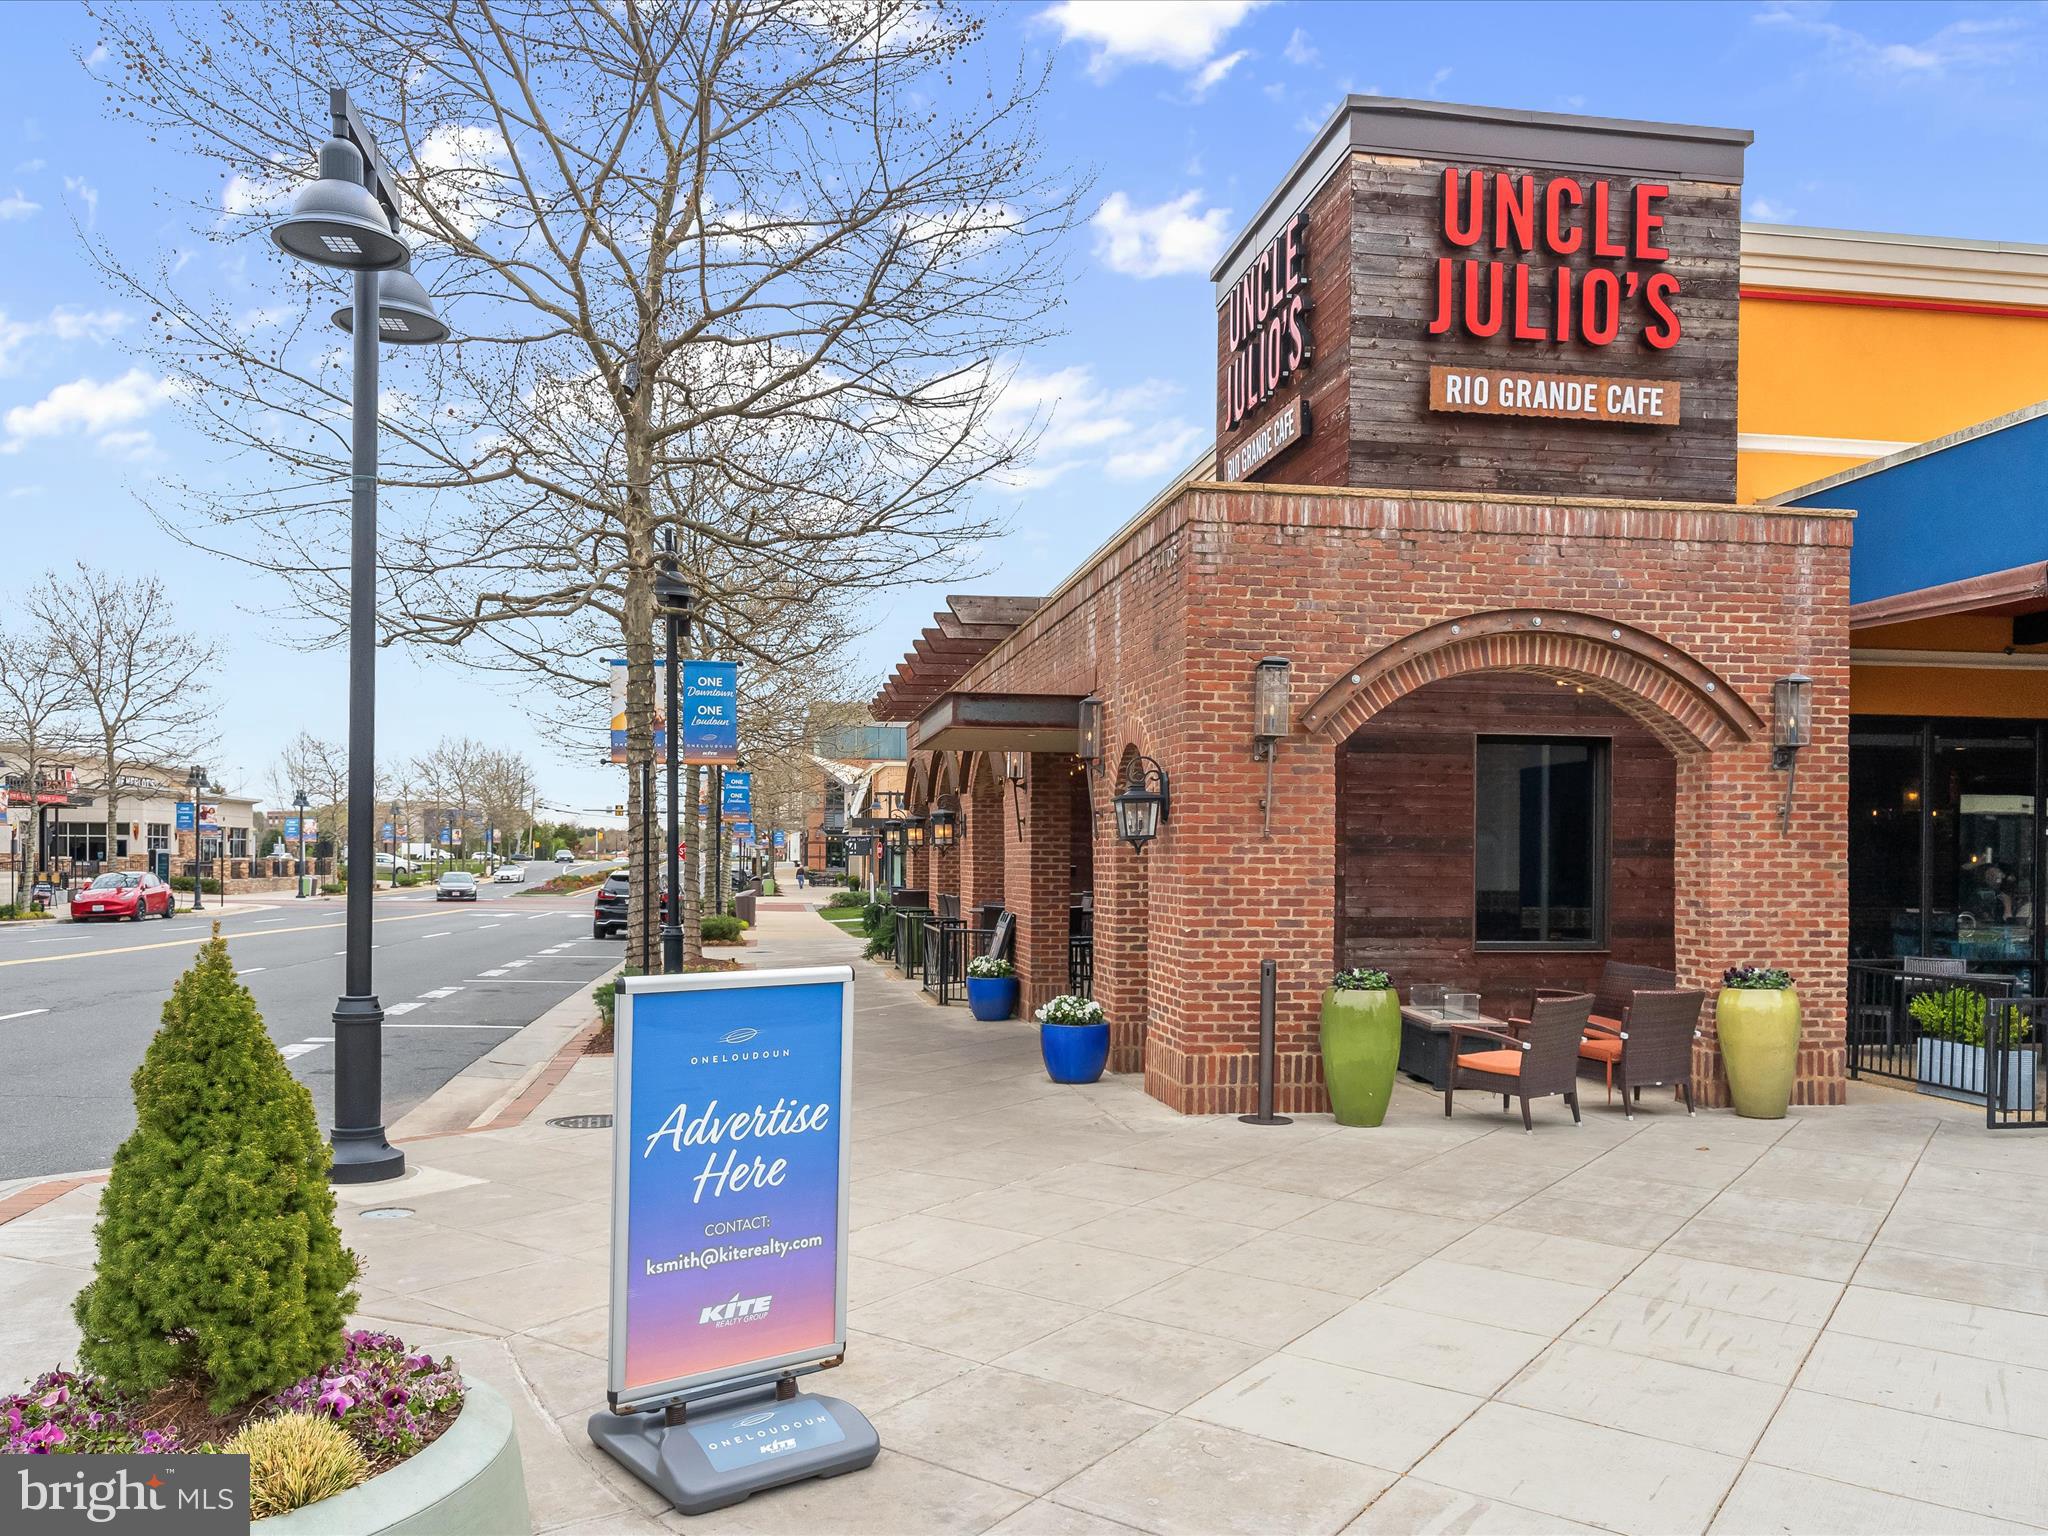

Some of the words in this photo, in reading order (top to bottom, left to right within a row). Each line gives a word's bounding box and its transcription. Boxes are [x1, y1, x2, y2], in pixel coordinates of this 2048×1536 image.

[1442, 168, 1670, 261] UNCLE
[1229, 213, 1304, 353] UNCLE
[1428, 257, 1682, 350] JULIO'S
[1225, 294, 1305, 431] JULIO'S
[1445, 374, 1490, 406] RIO
[1498, 378, 1598, 413] GRANDE
[1606, 384, 1664, 417] CAFE
[1227, 452, 1240, 482] RIO
[1241, 430, 1272, 474] GRANDE
[1274, 407, 1295, 448] CAFE
[687, 686, 735, 698] Downtown
[697, 676, 723, 687] ONE
[691, 716, 730, 726] Loudoun
[697, 705, 723, 716] ONE
[690, 1049, 791, 1065] ONELOUDOUN
[643, 1098, 830, 1159] Advertise
[692, 1149, 788, 1204] Here
[704, 1215, 771, 1237] CONTACT:
[645, 1234, 823, 1275] ksmith@kiterealty.com
[698, 1292, 773, 1325] KITE
[715, 1316, 744, 1328] REALTY
[743, 1311, 768, 1323] GROUP
[708, 1415, 828, 1451] ONELOUDOUN
